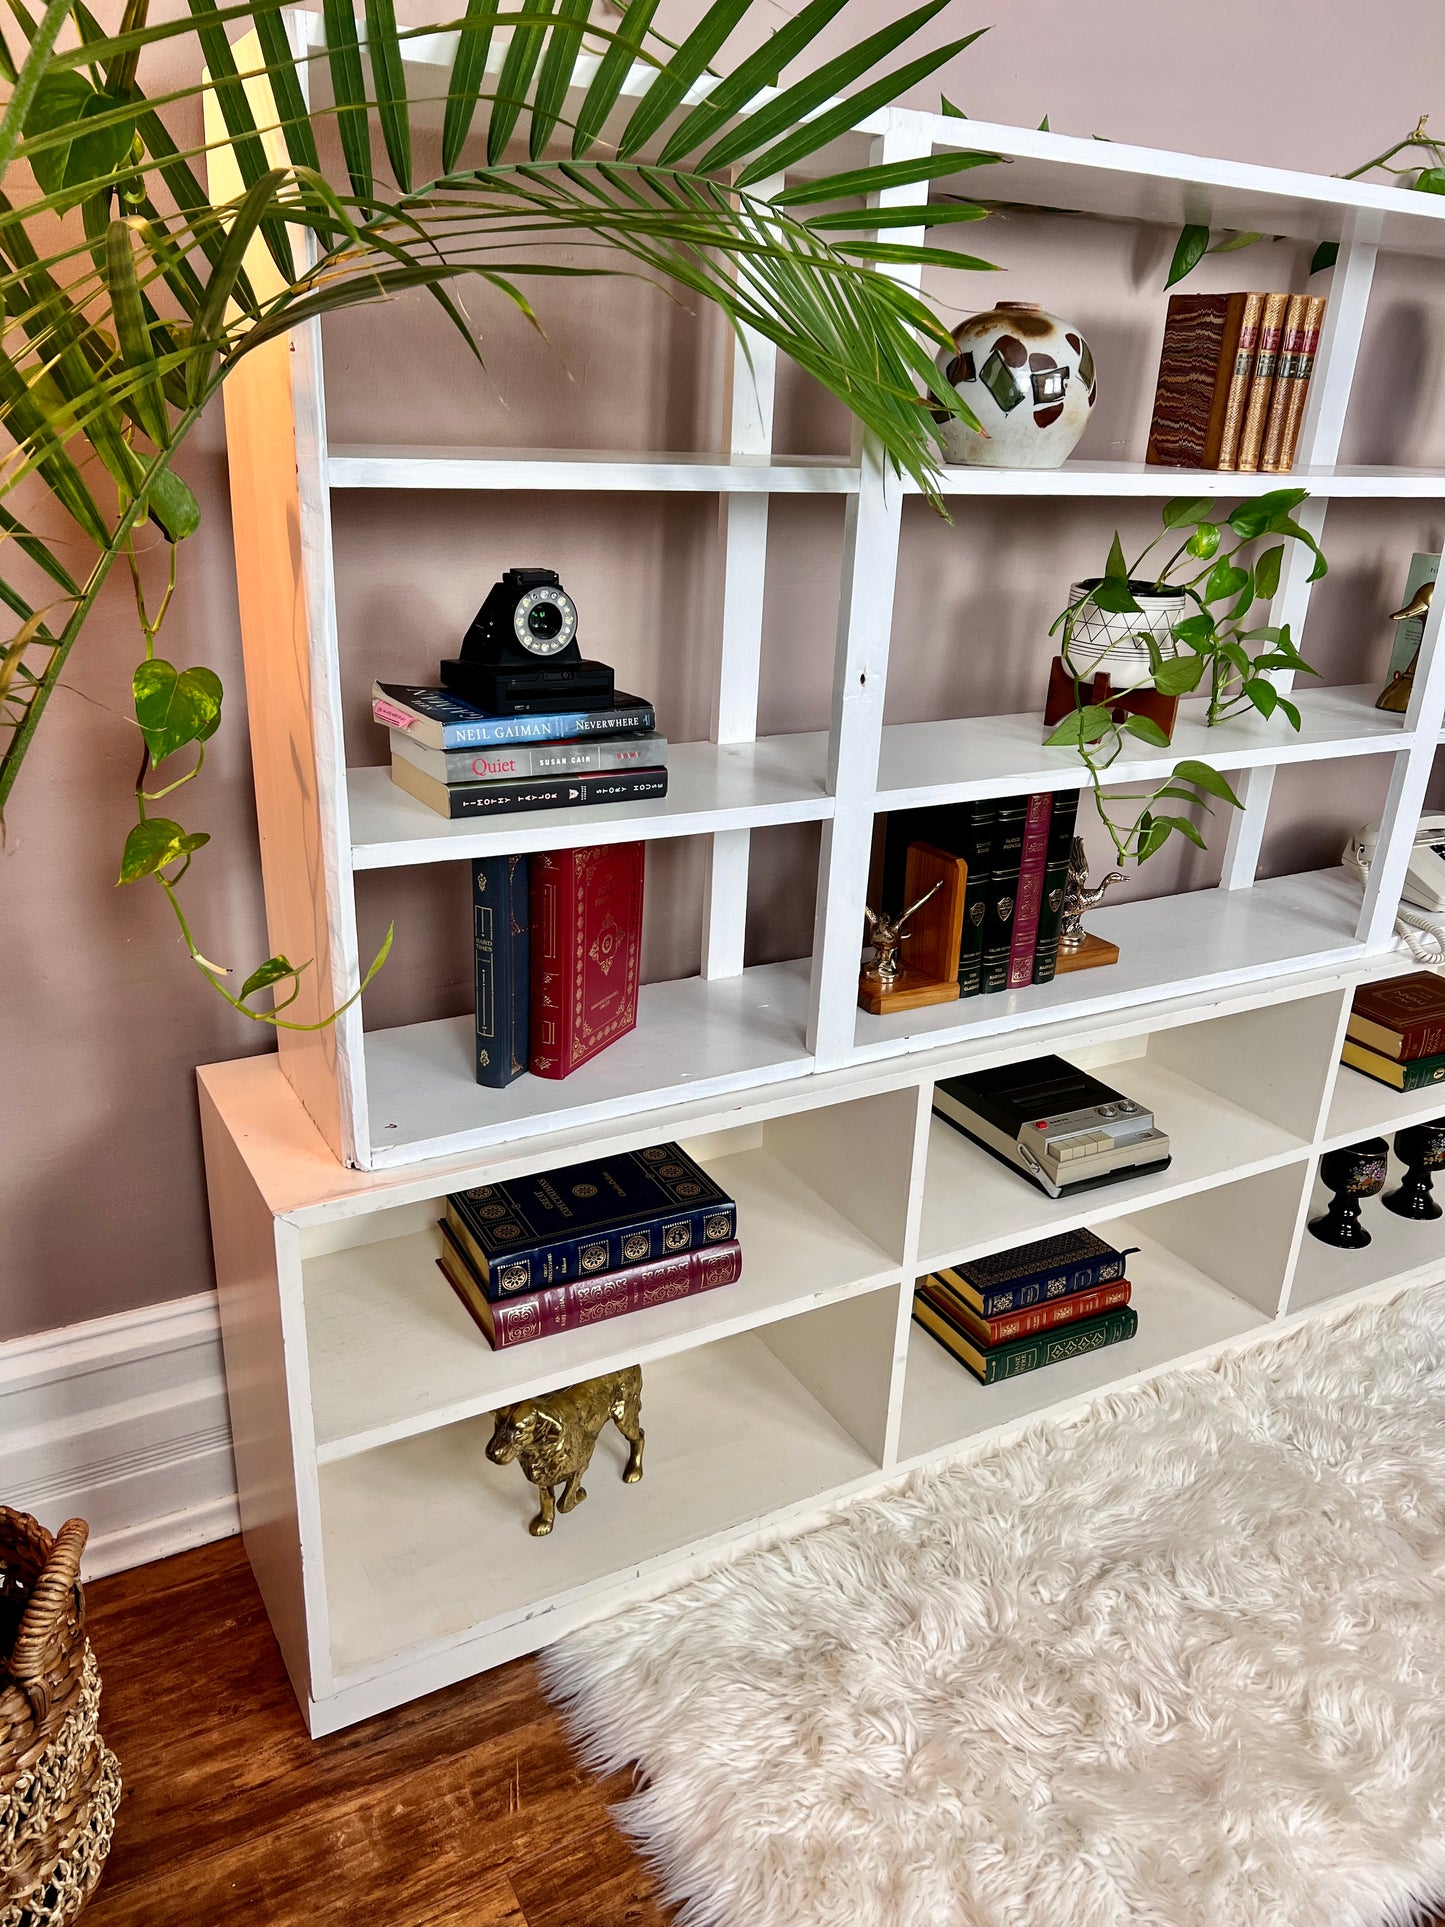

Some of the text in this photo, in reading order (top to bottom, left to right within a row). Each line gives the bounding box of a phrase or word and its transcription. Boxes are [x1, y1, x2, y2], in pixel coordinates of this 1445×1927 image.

[456, 727, 491, 743] NEIL
[494, 723, 552, 740] GAIMAN
[575, 716, 640, 732] NEVERWHERE
[471, 754, 591, 777] Quiet SUSAN CAIN
[463, 797, 512, 807] TIMOTHY
[517, 792, 558, 802] TAYLOR
[596, 786, 628, 795] STORY
[633, 783, 664, 792] HOUSE
[475, 937, 493, 947] HARD
[537, 1178, 573, 1218] EXPECTATIONS
